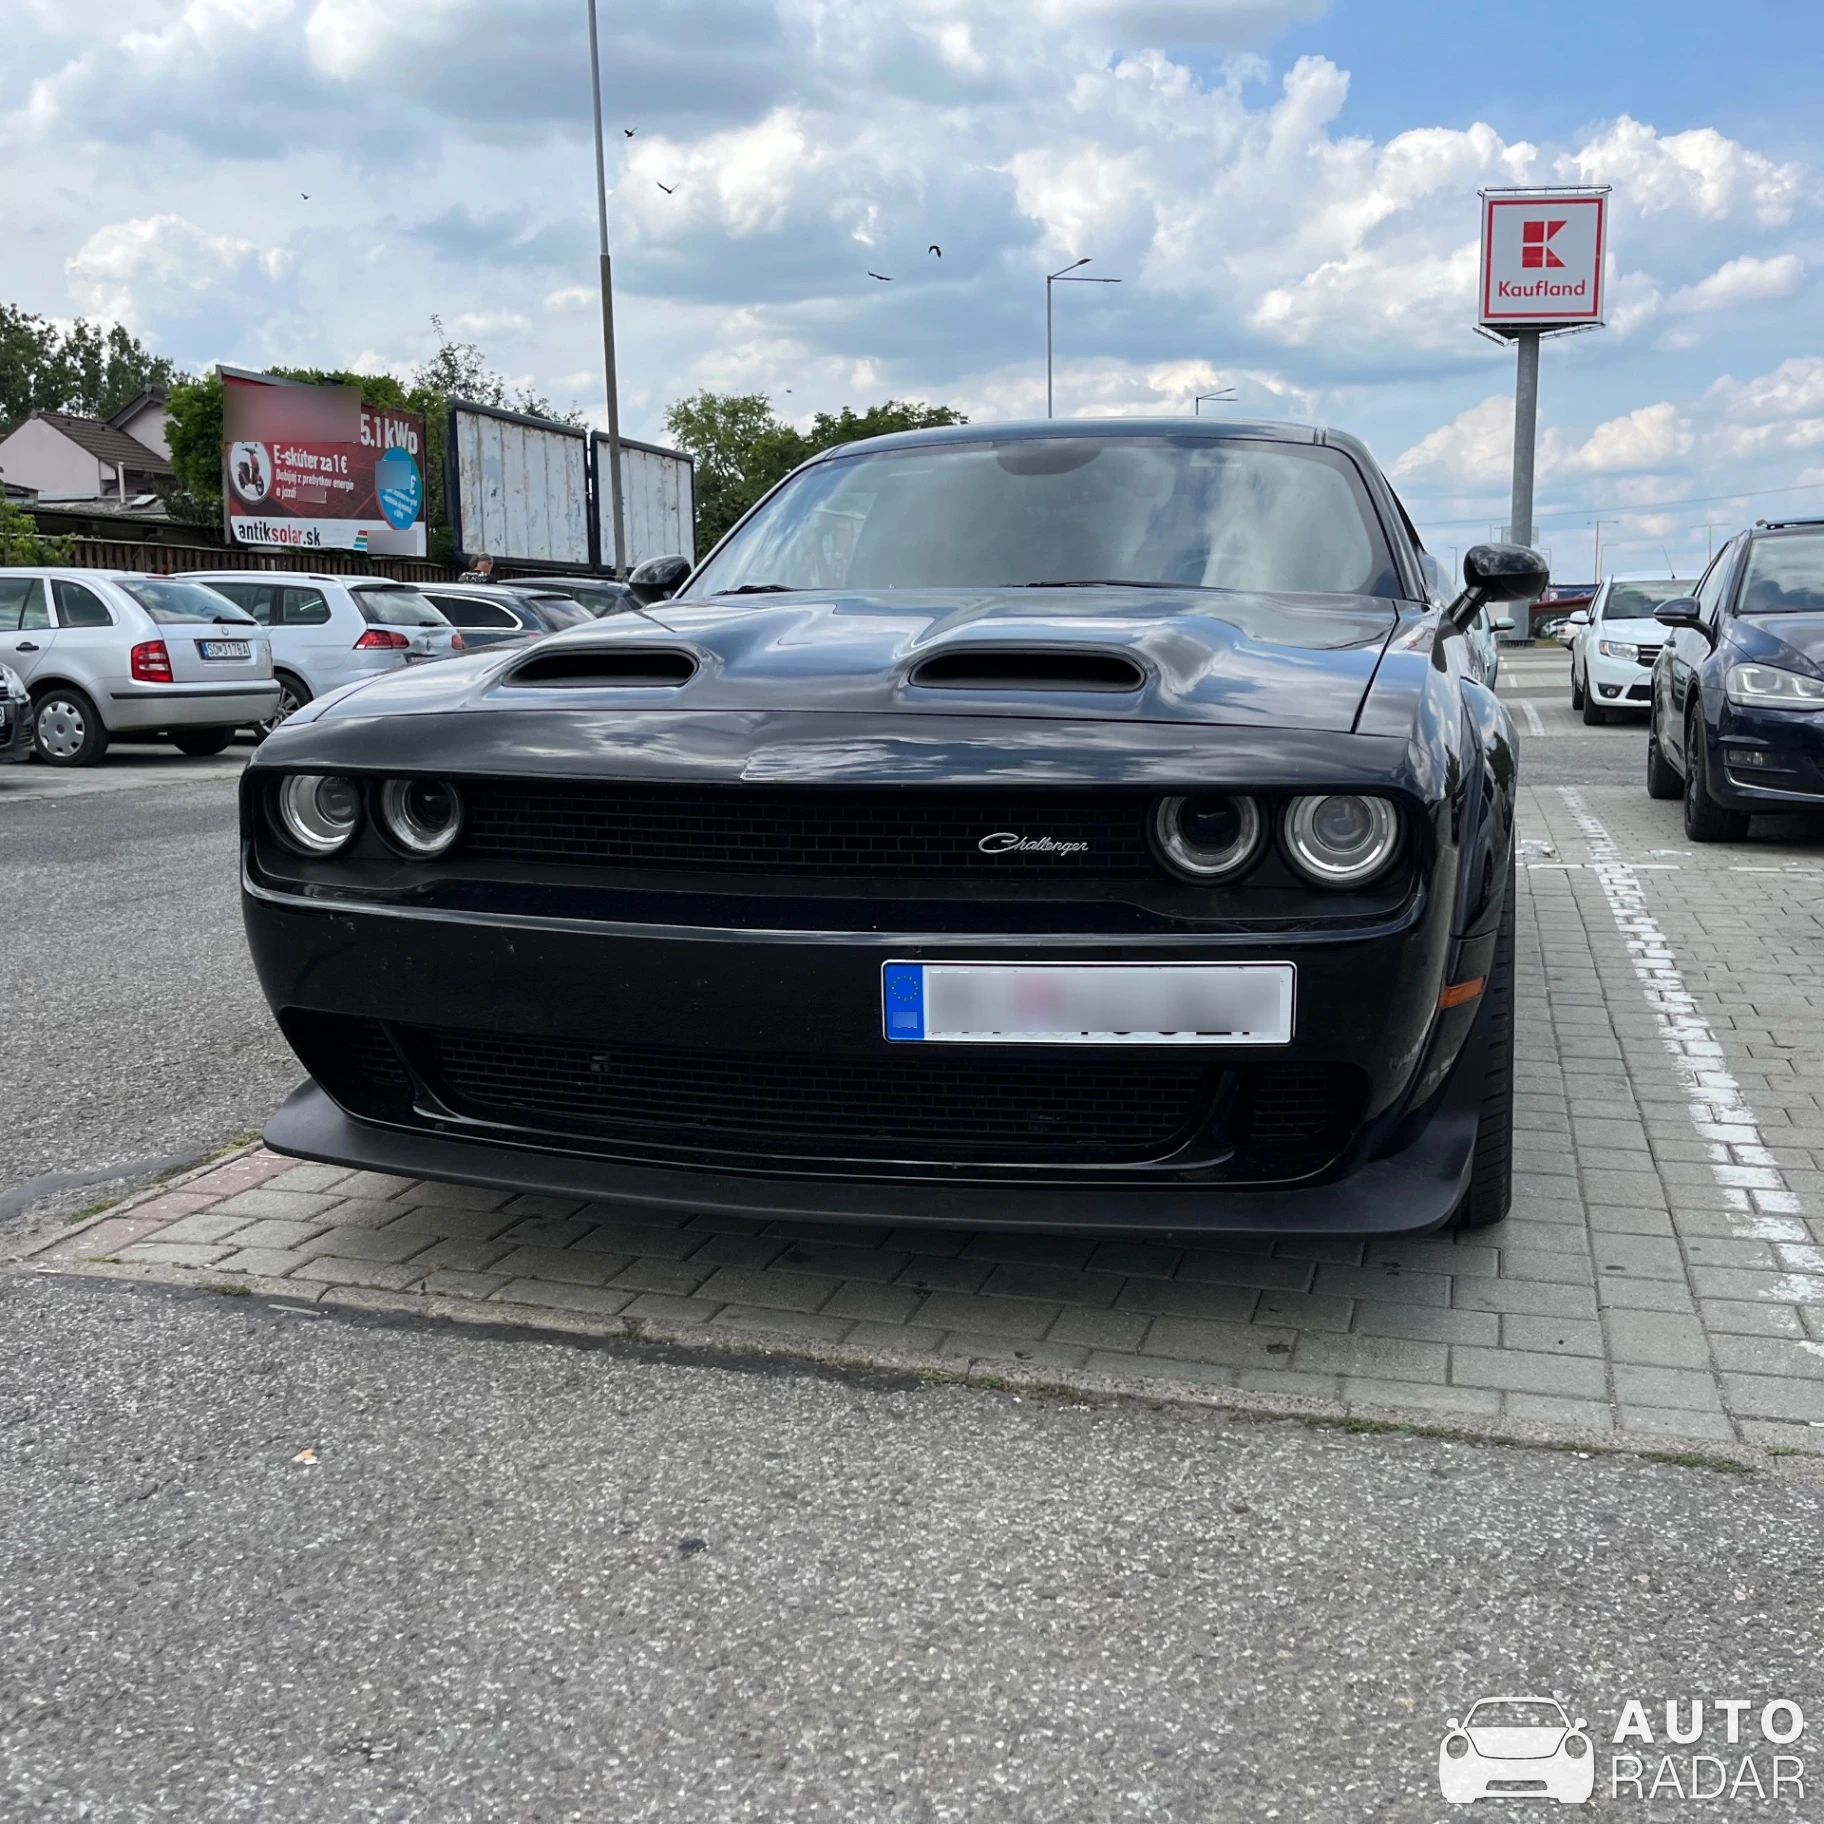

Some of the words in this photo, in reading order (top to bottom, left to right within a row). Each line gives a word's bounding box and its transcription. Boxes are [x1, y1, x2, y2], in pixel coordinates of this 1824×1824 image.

[1498, 280, 1585, 297] Kaufland
[360, 413, 381, 448] 5.1
[384, 418, 418, 455] kWp
[273, 444, 318, 469] E-skúter
[320, 456, 333, 472] za
[333, 454, 339, 473] 1
[341, 455, 348, 474] €
[238, 521, 321, 546] antiksolar.sk
[978, 832, 1089, 856] Challenger
